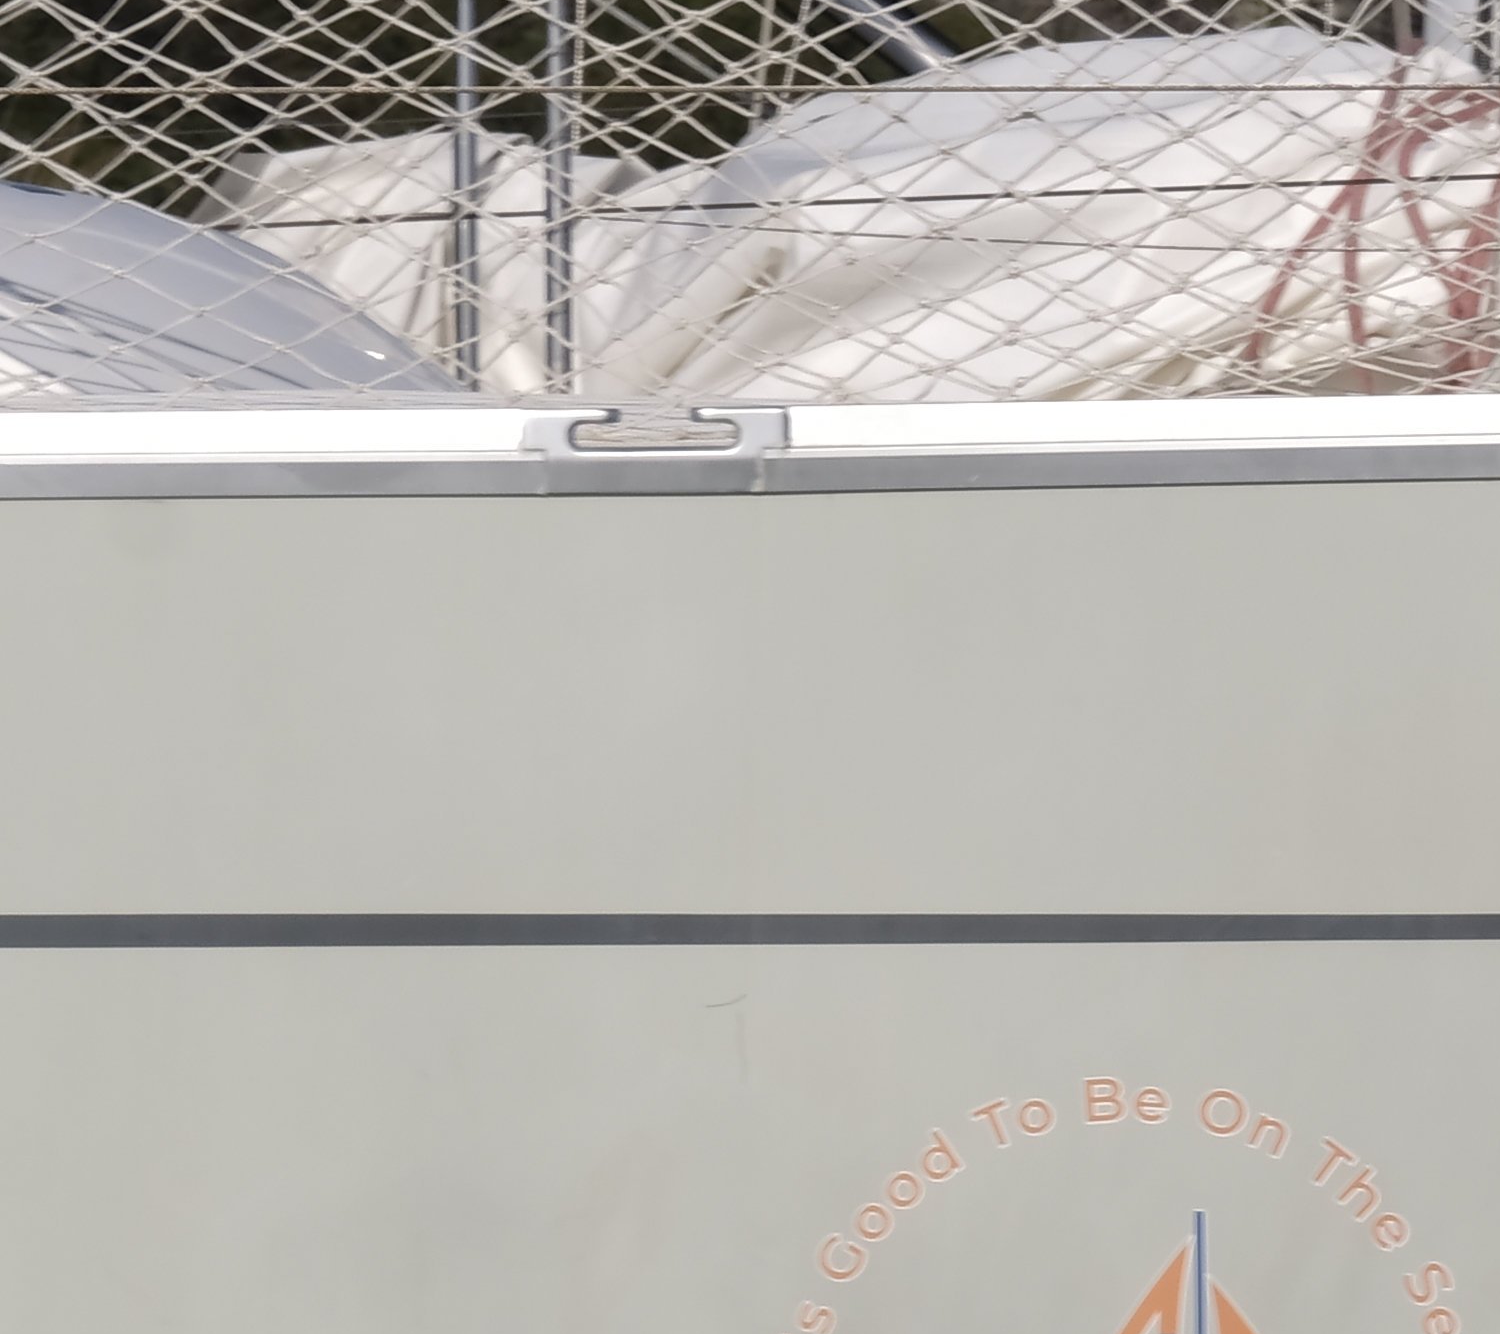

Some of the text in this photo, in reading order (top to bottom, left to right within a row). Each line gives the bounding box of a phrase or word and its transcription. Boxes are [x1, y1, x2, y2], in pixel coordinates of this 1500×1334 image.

[817, 1129, 965, 1282] Good
[972, 1096, 1057, 1148] To
[1083, 1076, 1171, 1124] Be
[1200, 1088, 1291, 1159] On
[1308, 1137, 1411, 1252] The
